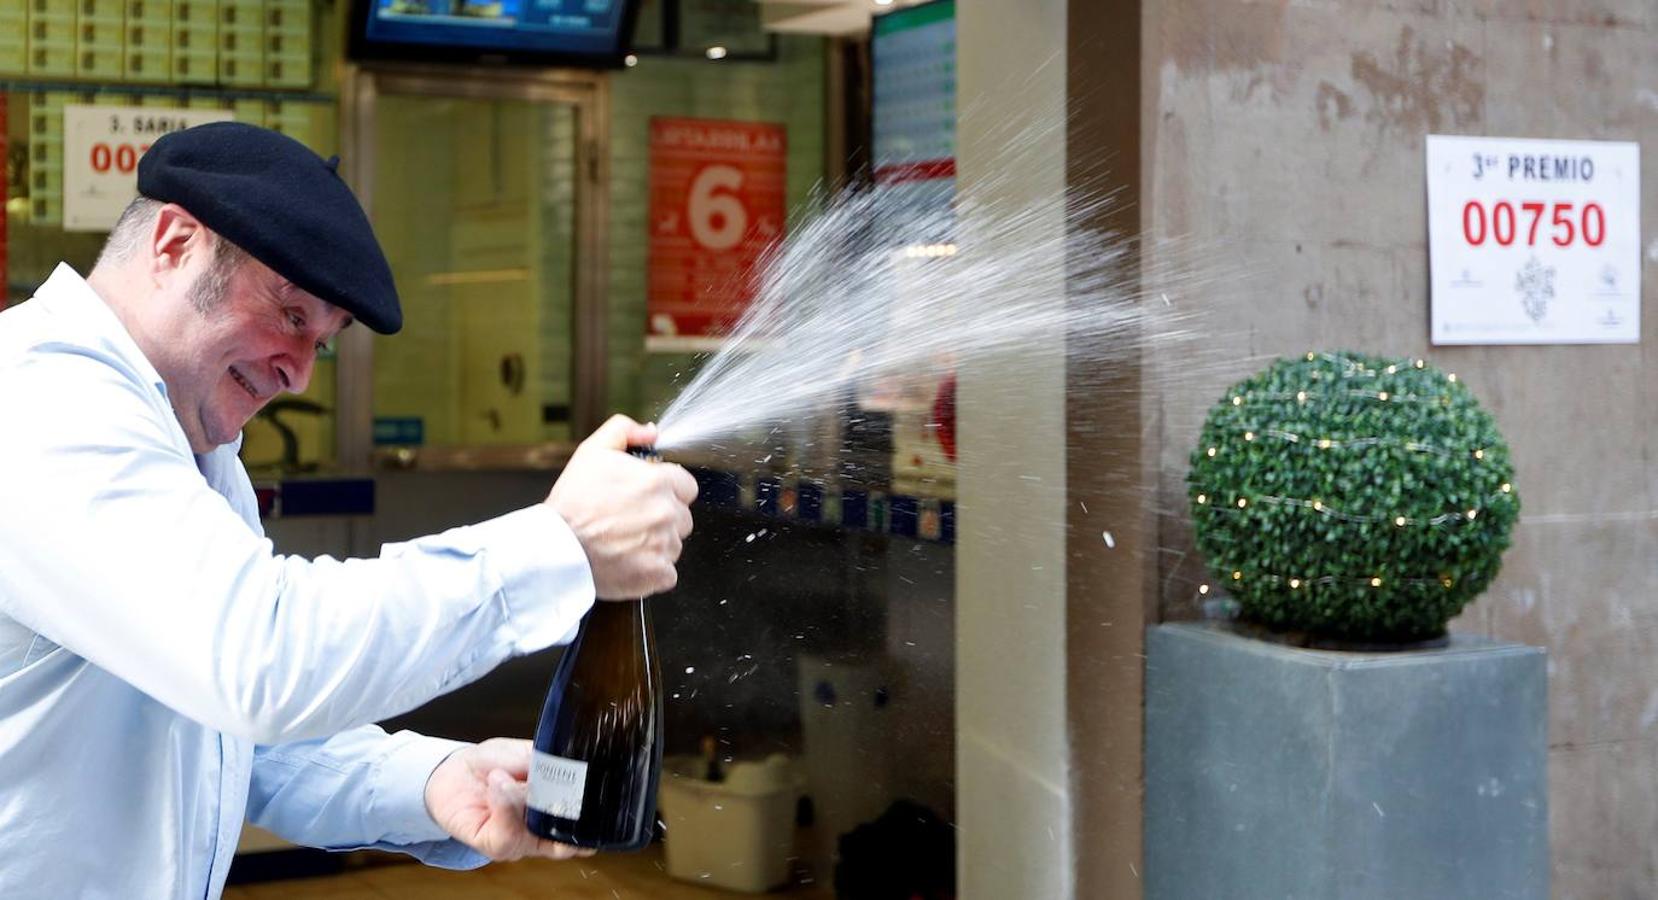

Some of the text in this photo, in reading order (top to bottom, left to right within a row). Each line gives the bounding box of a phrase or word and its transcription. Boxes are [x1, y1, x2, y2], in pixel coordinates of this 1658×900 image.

[90, 143, 150, 173] 00
[1508, 155, 1594, 181] PREMIO
[688, 165, 747, 249] 6
[1462, 199, 1606, 249] 00750
